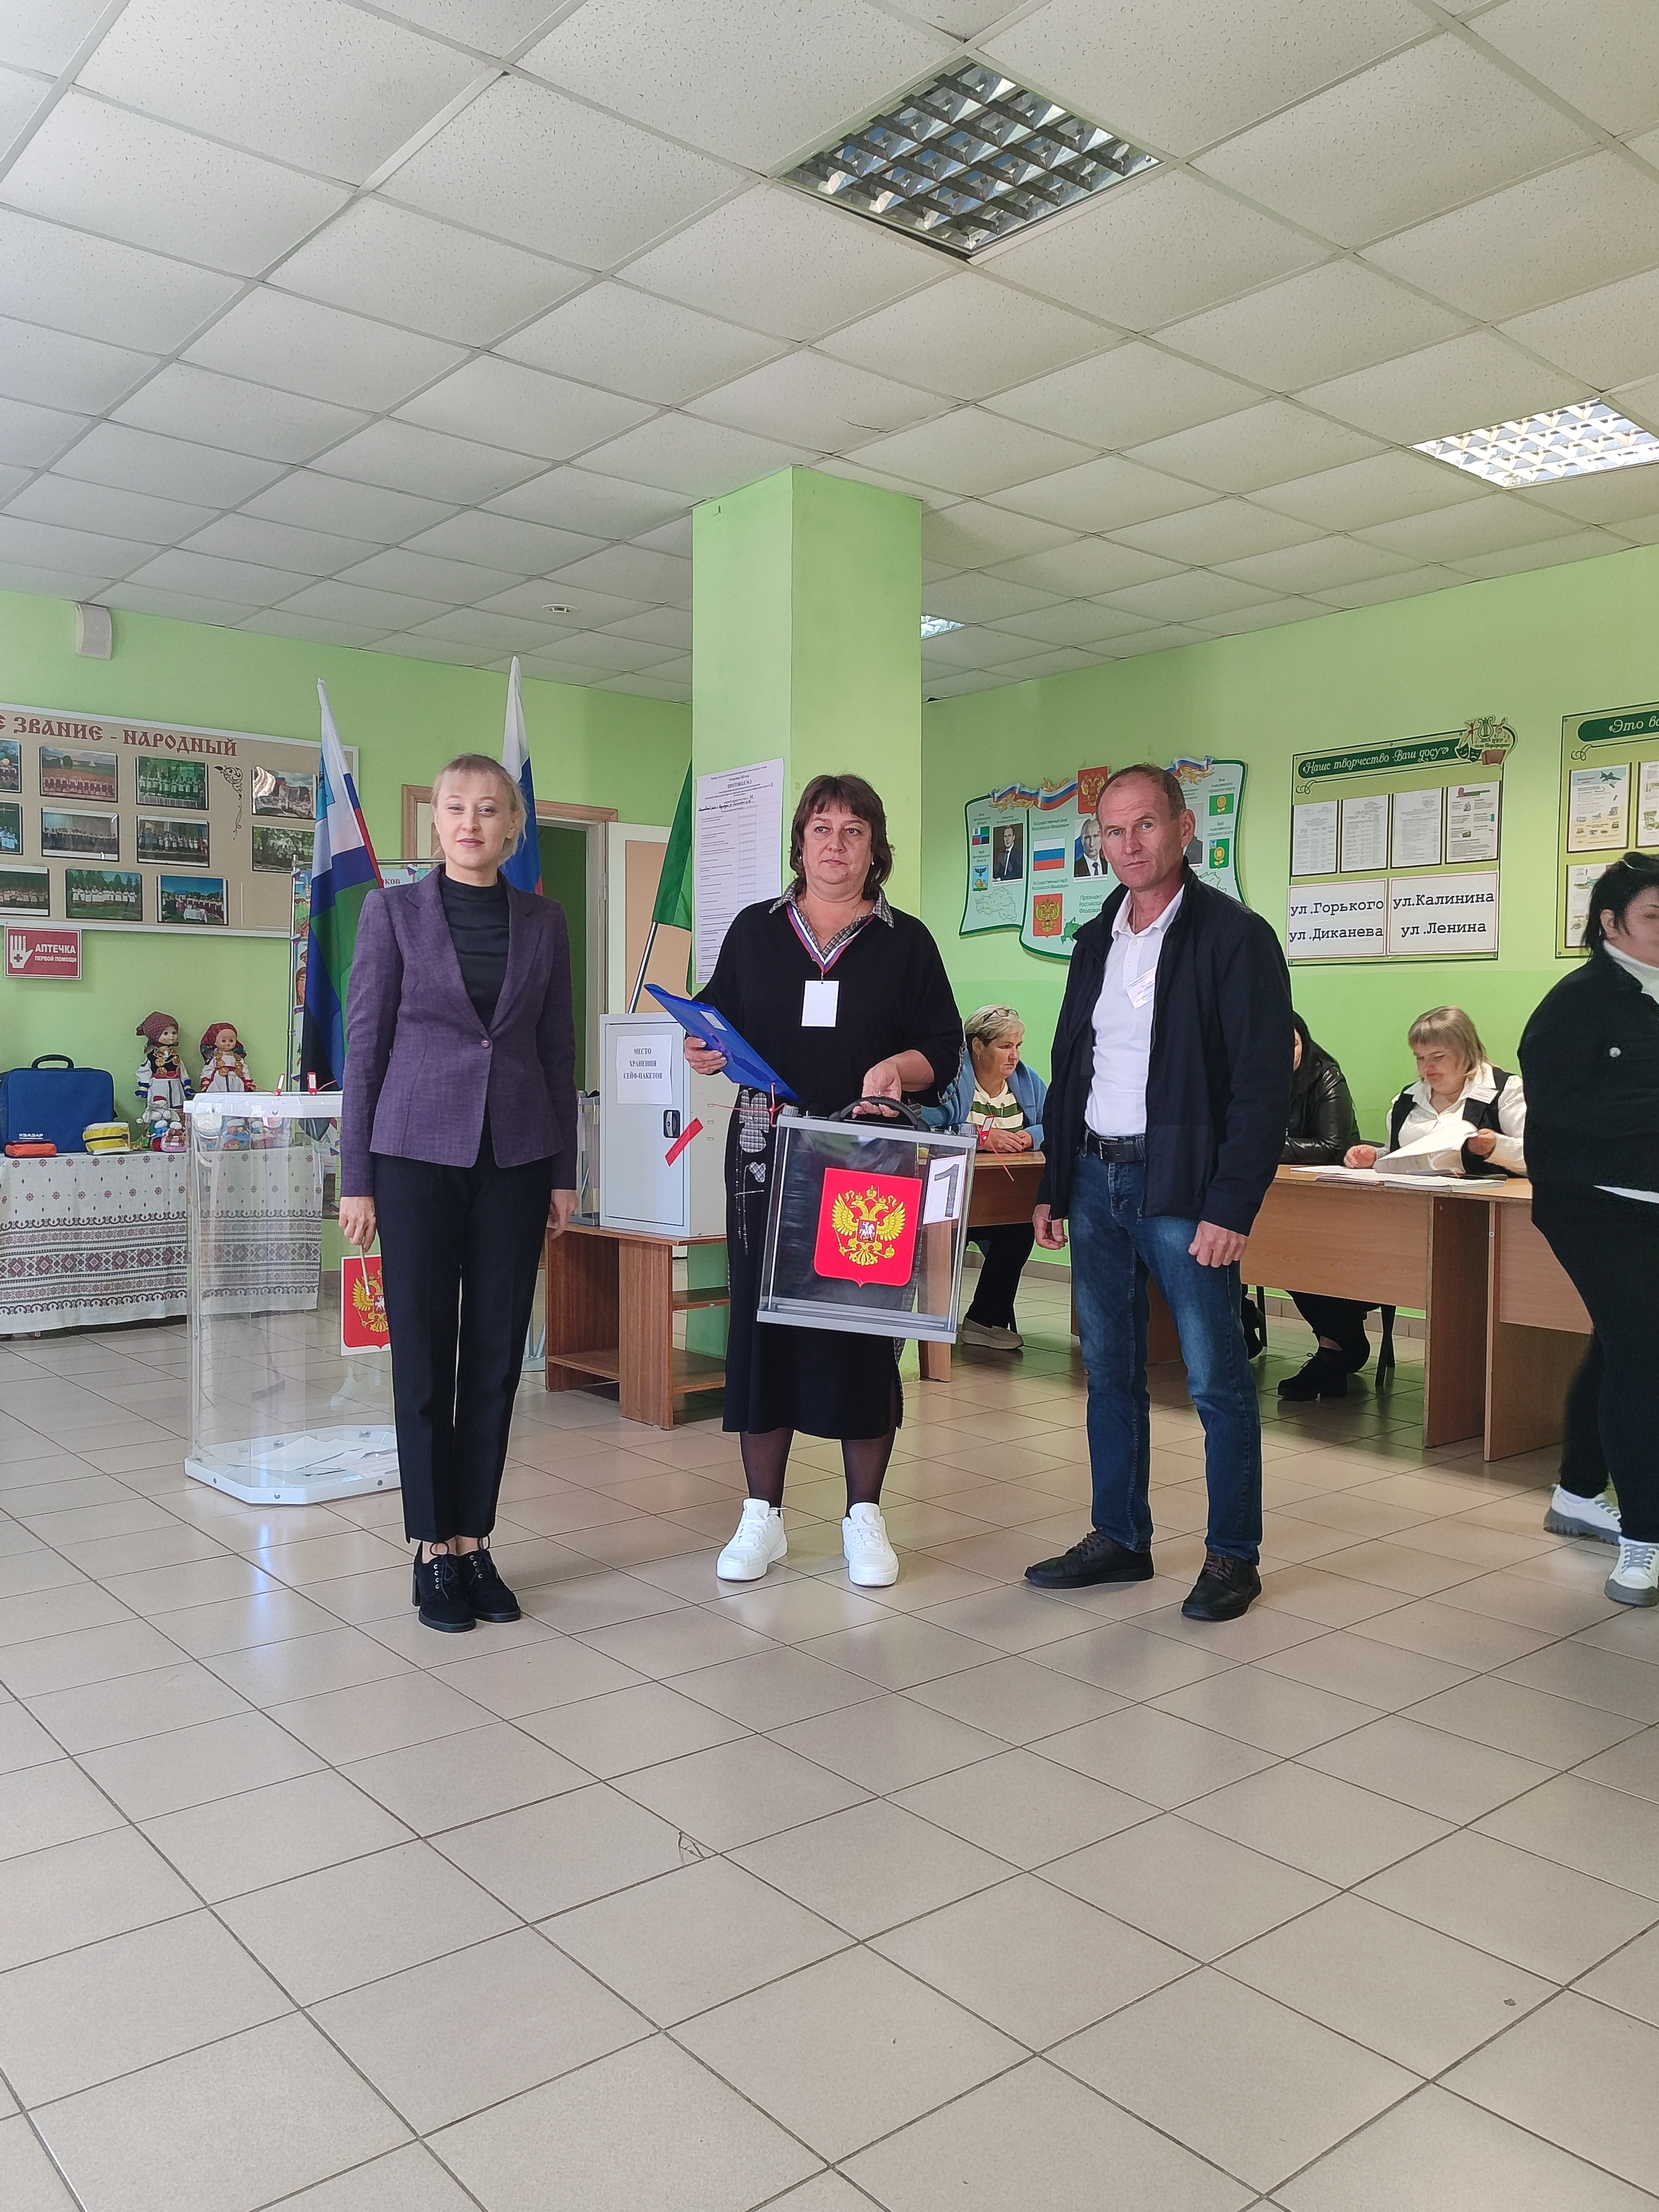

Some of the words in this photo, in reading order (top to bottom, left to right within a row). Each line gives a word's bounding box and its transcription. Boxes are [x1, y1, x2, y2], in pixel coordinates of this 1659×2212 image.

[14, 717, 103, 740] ЗВАНИЕ
[123, 729, 237, 757] НАРОДНЫЙ
[1333, 753, 1389, 771] творчество
[35, 943, 76, 954] АПТЕЧКА
[934, 1164, 959, 1218] 1
